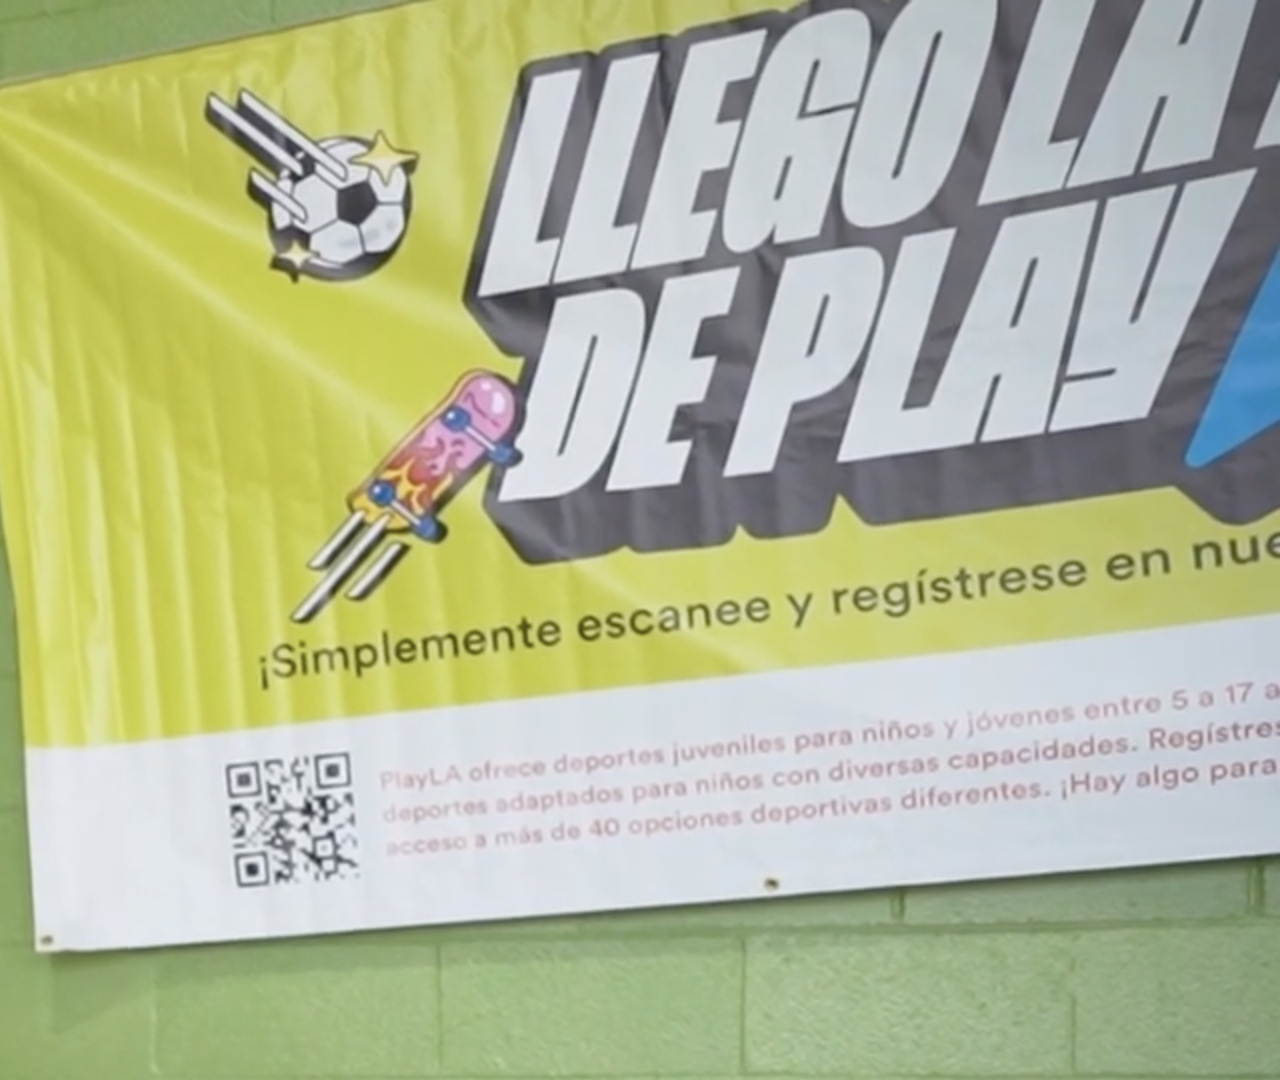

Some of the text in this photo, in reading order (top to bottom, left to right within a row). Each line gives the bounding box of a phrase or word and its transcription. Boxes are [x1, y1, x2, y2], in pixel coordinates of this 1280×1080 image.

[479, 0, 1253, 297] LLEGO LA
[498, 267, 741, 502] DE
[723, 168, 1258, 478] PLAY
[259, 617, 562, 690] ¡Simplemente
[577, 597, 771, 642] escanee
[786, 592, 813, 628] y
[832, 557, 1088, 618] regístrese
[1106, 546, 1171, 581] en
[380, 763, 462, 792] PlayLA
[469, 756, 546, 783] ofrece
[553, 745, 665, 779] deportes
[672, 733, 785, 766] juveniles
[794, 727, 853, 756] para
[862, 716, 934, 744] niños
[943, 717, 959, 740] y
[966, 703, 1075, 737] jóvenes
[1083, 695, 1161, 721] entre
[1171, 689, 1189, 711] 5
[1198, 690, 1214, 708] a
[1225, 682, 1254, 705] 17
[382, 797, 488, 825] deportes
[496, 783, 624, 817] adaptados
[632, 780, 688, 806] para
[696, 766, 764, 796] niños
[772, 768, 820, 788] con
[828, 755, 940, 783] diversas
[947, 732, 1138, 772] capacidades.
[386, 757, 1278, 857] acceso a más de 40 opciones deportivas diferentes. ¡Hay algo para
